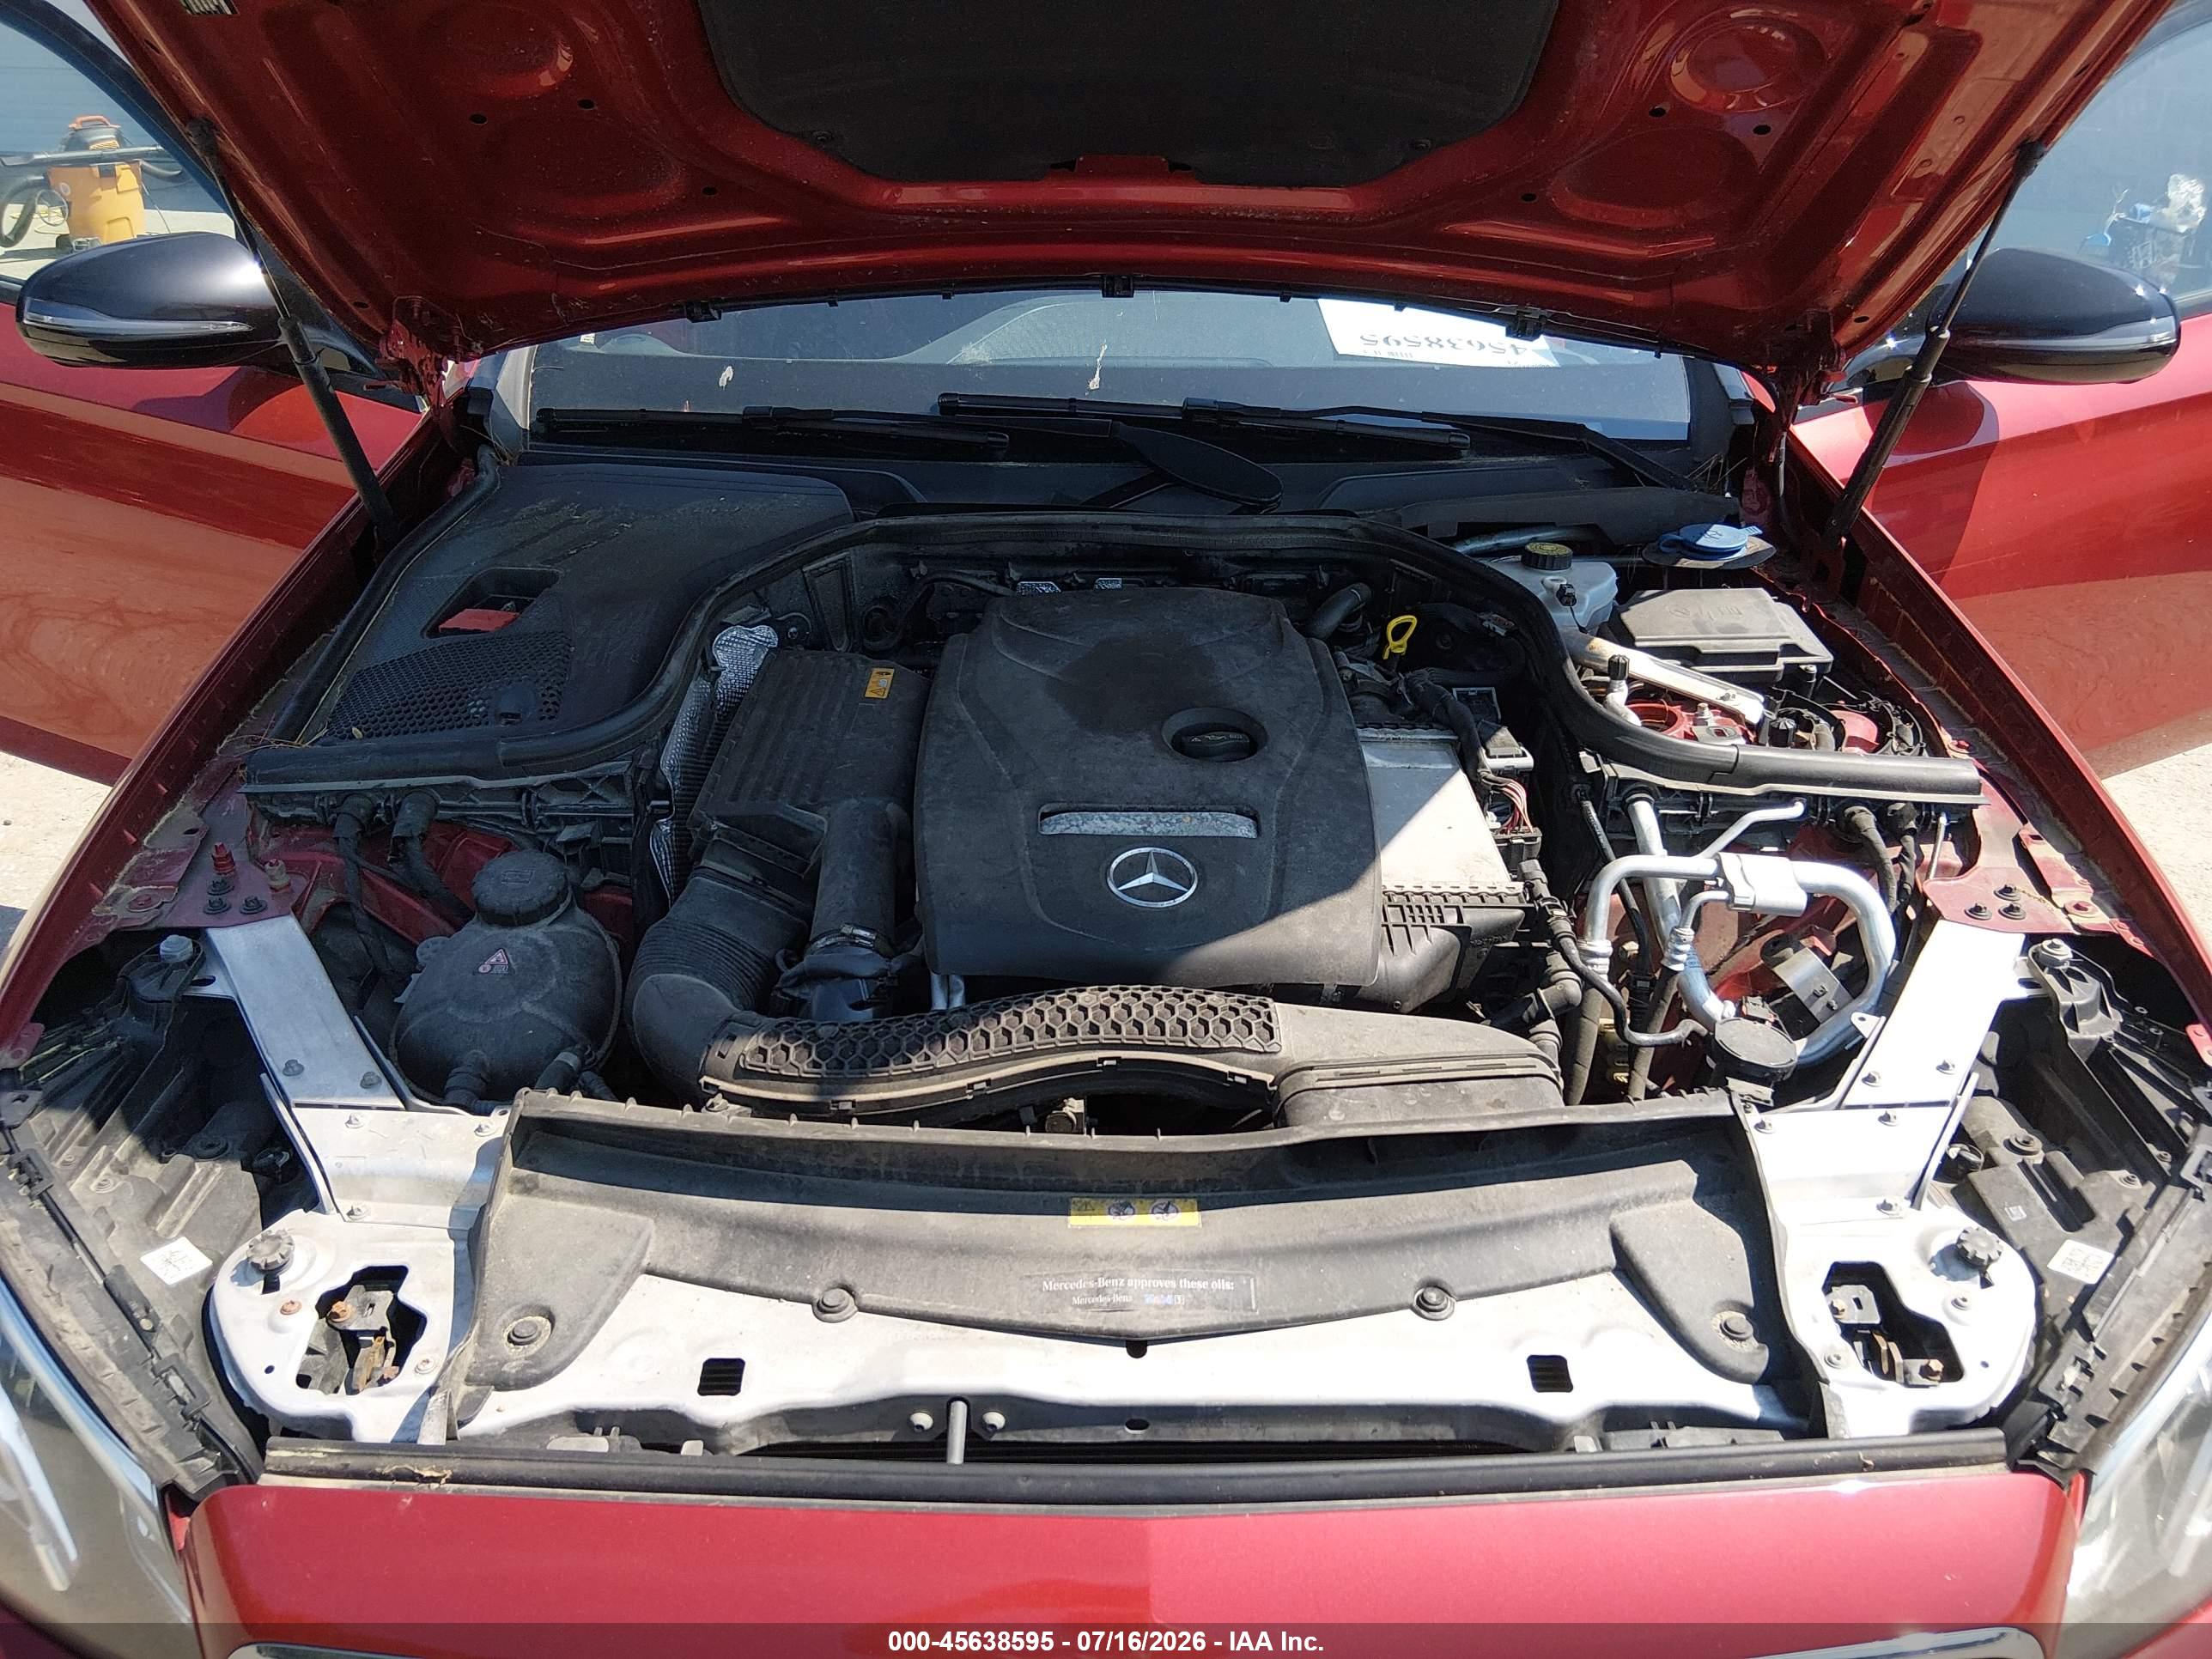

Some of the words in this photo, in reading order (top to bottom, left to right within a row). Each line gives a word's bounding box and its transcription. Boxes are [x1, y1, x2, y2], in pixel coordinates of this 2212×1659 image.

[1042, 1278, 1125, 1291] Mercedes-Benz
[1127, 1278, 1176, 1291] approves
[1179, 1277, 1208, 1290] these
[1211, 1278, 1234, 1291] oils:
